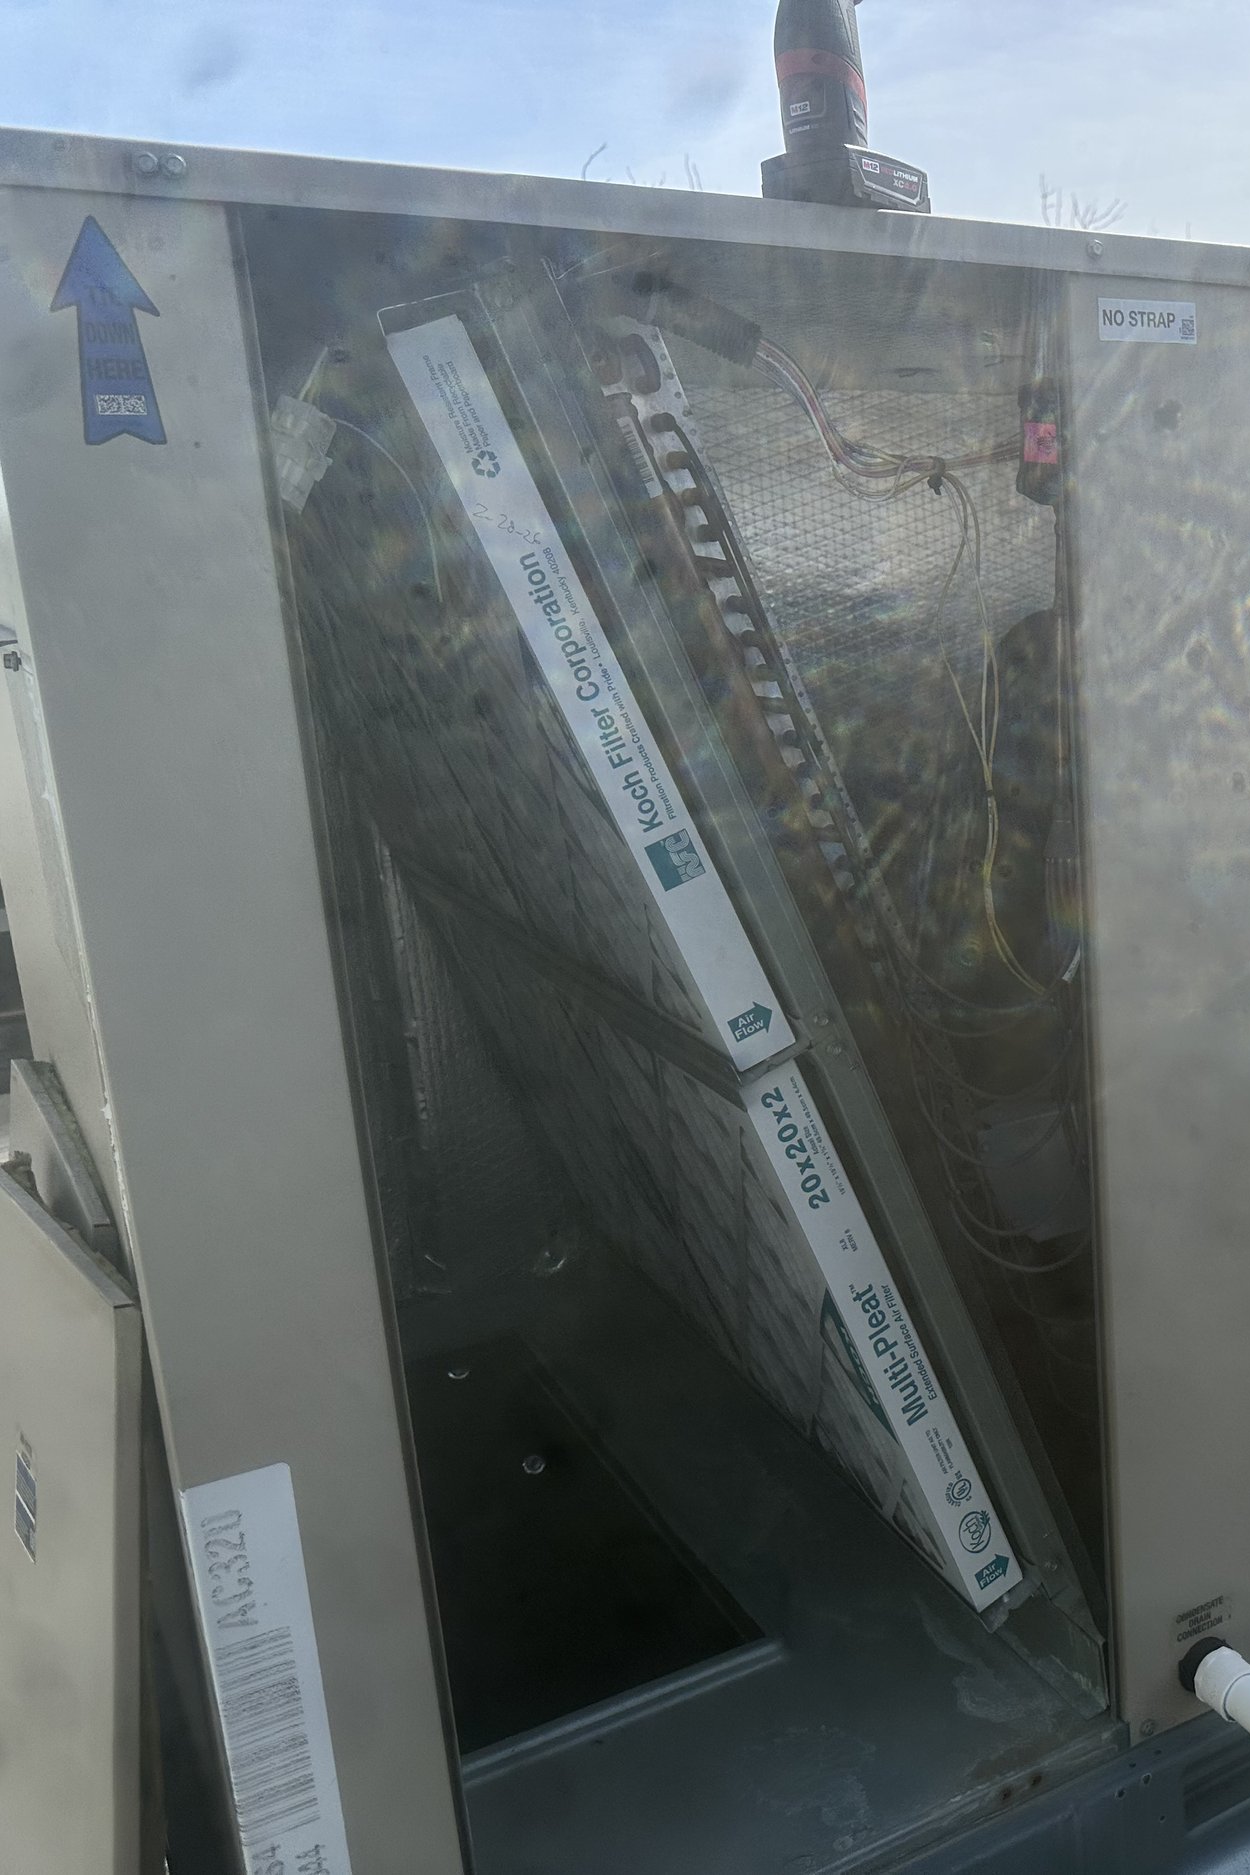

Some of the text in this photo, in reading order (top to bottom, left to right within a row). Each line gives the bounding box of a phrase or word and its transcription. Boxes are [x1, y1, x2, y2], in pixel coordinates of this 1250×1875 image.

[863, 159, 879, 172] M12
[85, 321, 137, 344] DOWN
[1102, 308, 1176, 329] NO STRAP
[86, 357, 147, 380] HERE
[541, 546, 560, 575] 40208
[556, 575, 580, 615] Kentucky
[519, 552, 663, 832] Koch Filter Corporation
[600, 667, 616, 692] Pride
[611, 691, 625, 711] with
[619, 711, 640, 744] Crafted
[636, 743, 659, 782] Products
[655, 782, 677, 820] Filtration
[733, 1017, 765, 1040] Flow
[735, 1011, 756, 1027] Air
[760, 1087, 829, 1209] 20x20x2
[852, 1284, 927, 1425] Multi-Pleat
[880, 1284, 937, 1400] Extended Surface Air Filter
[962, 1518, 987, 1550] Koch
[199, 1508, 259, 1628] AC320
[978, 1566, 1004, 1587] Flow
[980, 1562, 997, 1577] Air
[1175, 1595, 1225, 1624] CONDENSATE
[1188, 1611, 1212, 1629] DRAIN
[1176, 1615, 1224, 1643] CONNECTION
